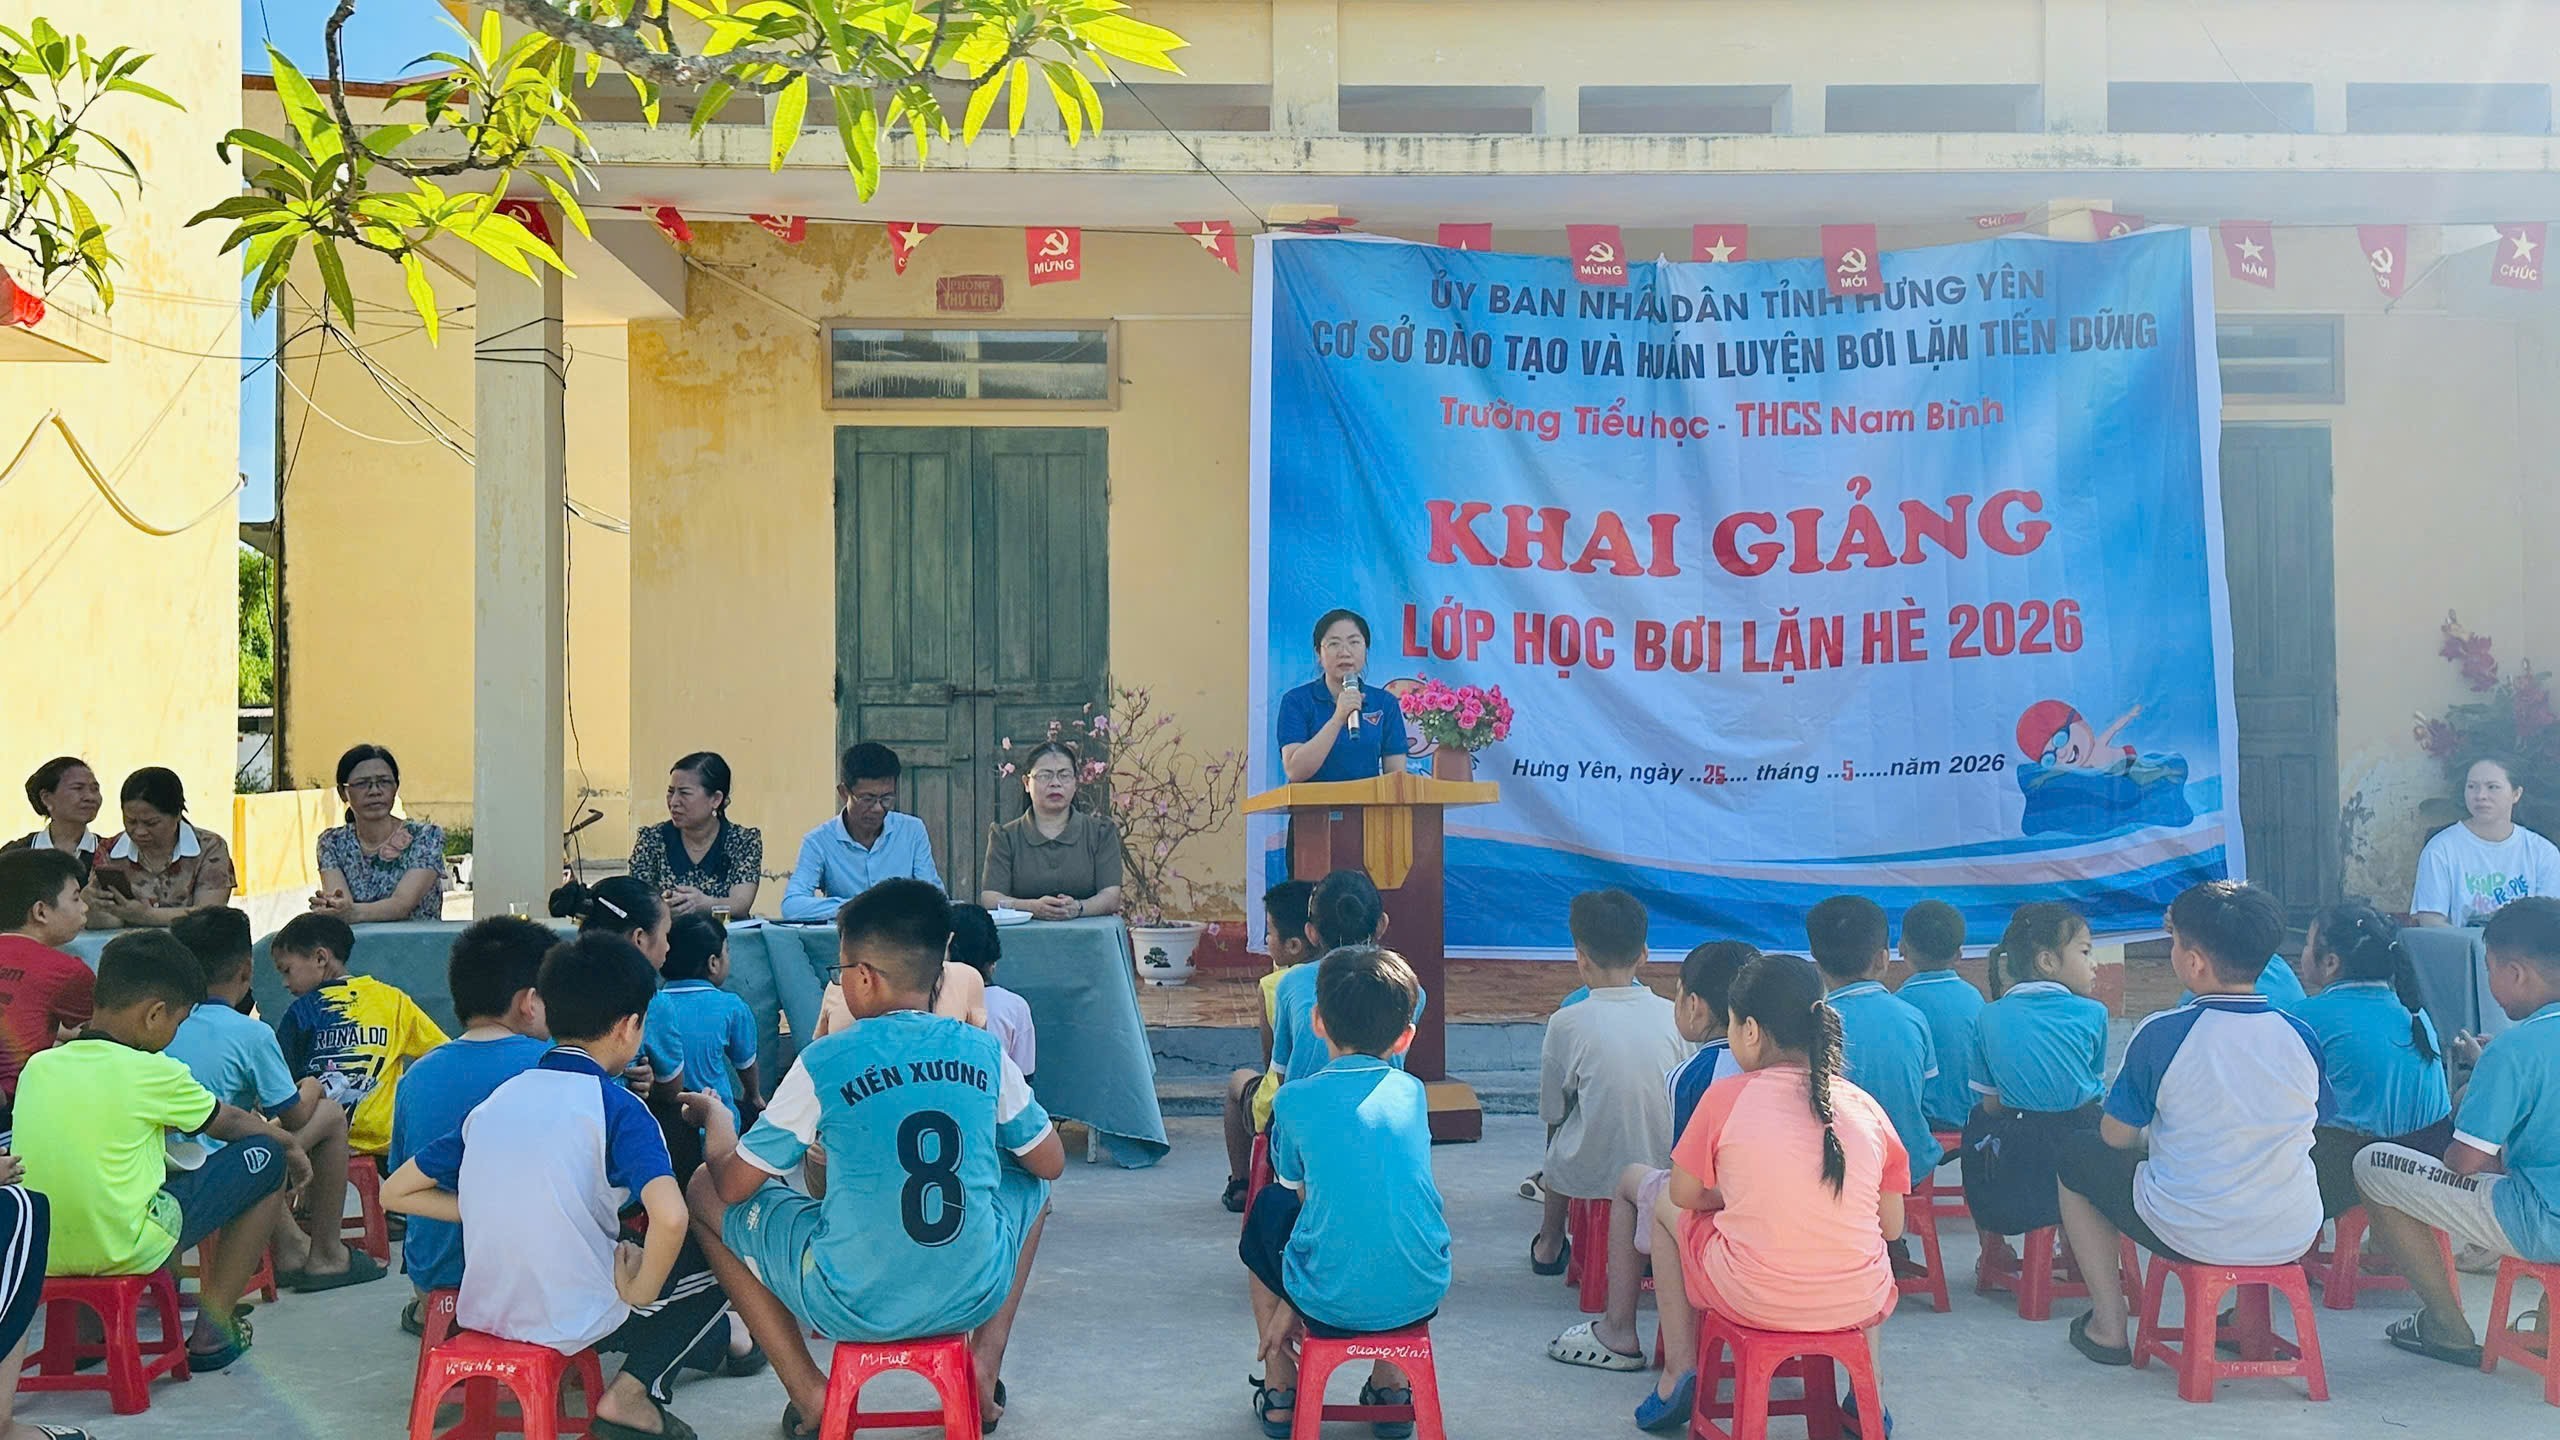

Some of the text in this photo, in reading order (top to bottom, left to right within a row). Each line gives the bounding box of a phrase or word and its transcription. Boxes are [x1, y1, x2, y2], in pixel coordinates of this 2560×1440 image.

[1034, 259, 1075, 275] MỪNG
[1580, 263, 1623, 276] MỪNG
[1840, 274, 1868, 288] MỚI
[2500, 263, 2538, 281] CHÚC
[1431, 269, 1477, 310] ỦY
[1489, 284, 1565, 318] BAN
[1671, 285, 1749, 323] DÂN
[1761, 279, 1843, 319] TỈNH
[1976, 262, 2045, 302] YÊN
[1313, 319, 1358, 359] CƠ
[1367, 314, 1416, 363] SỞ
[1424, 326, 1492, 369] ĐÀO
[1504, 335, 1568, 381] TẠO
[1581, 332, 1625, 376] VÀ
[1717, 330, 1825, 382] LUYỆN
[1837, 326, 1896, 371] BƠI
[1908, 317, 1969, 371] LẶN
[1980, 307, 2057, 357] TIẾN
[2069, 307, 2158, 353] DŨNG
[1440, 396, 1561, 442] Trường
[1574, 396, 1644, 438] Tiểu
[1650, 409, 1710, 448] học
[1736, 401, 1823, 437] THCS
[1832, 405, 1915, 435] Nam
[1926, 396, 2004, 431] Bình
[1425, 475, 2052, 578] KHAI GIẢNG
[1401, 595, 2085, 684] LỚP HỌC BƠI LẶN HÈ 2026
[1512, 759, 1569, 781] Hưng
[1577, 761, 1622, 782] Yên,
[1630, 762, 1684, 785] ngày
[1756, 762, 1819, 783] tháng
[1949, 753, 2005, 774] 2026
[314, 1025, 388, 1051] RONALDO
[840, 1059, 988, 1107] KIẾN XƯƠNG
[896, 1110, 967, 1248] 8
[2370, 1151, 2480, 1193] ADVANCE BRAVELY
